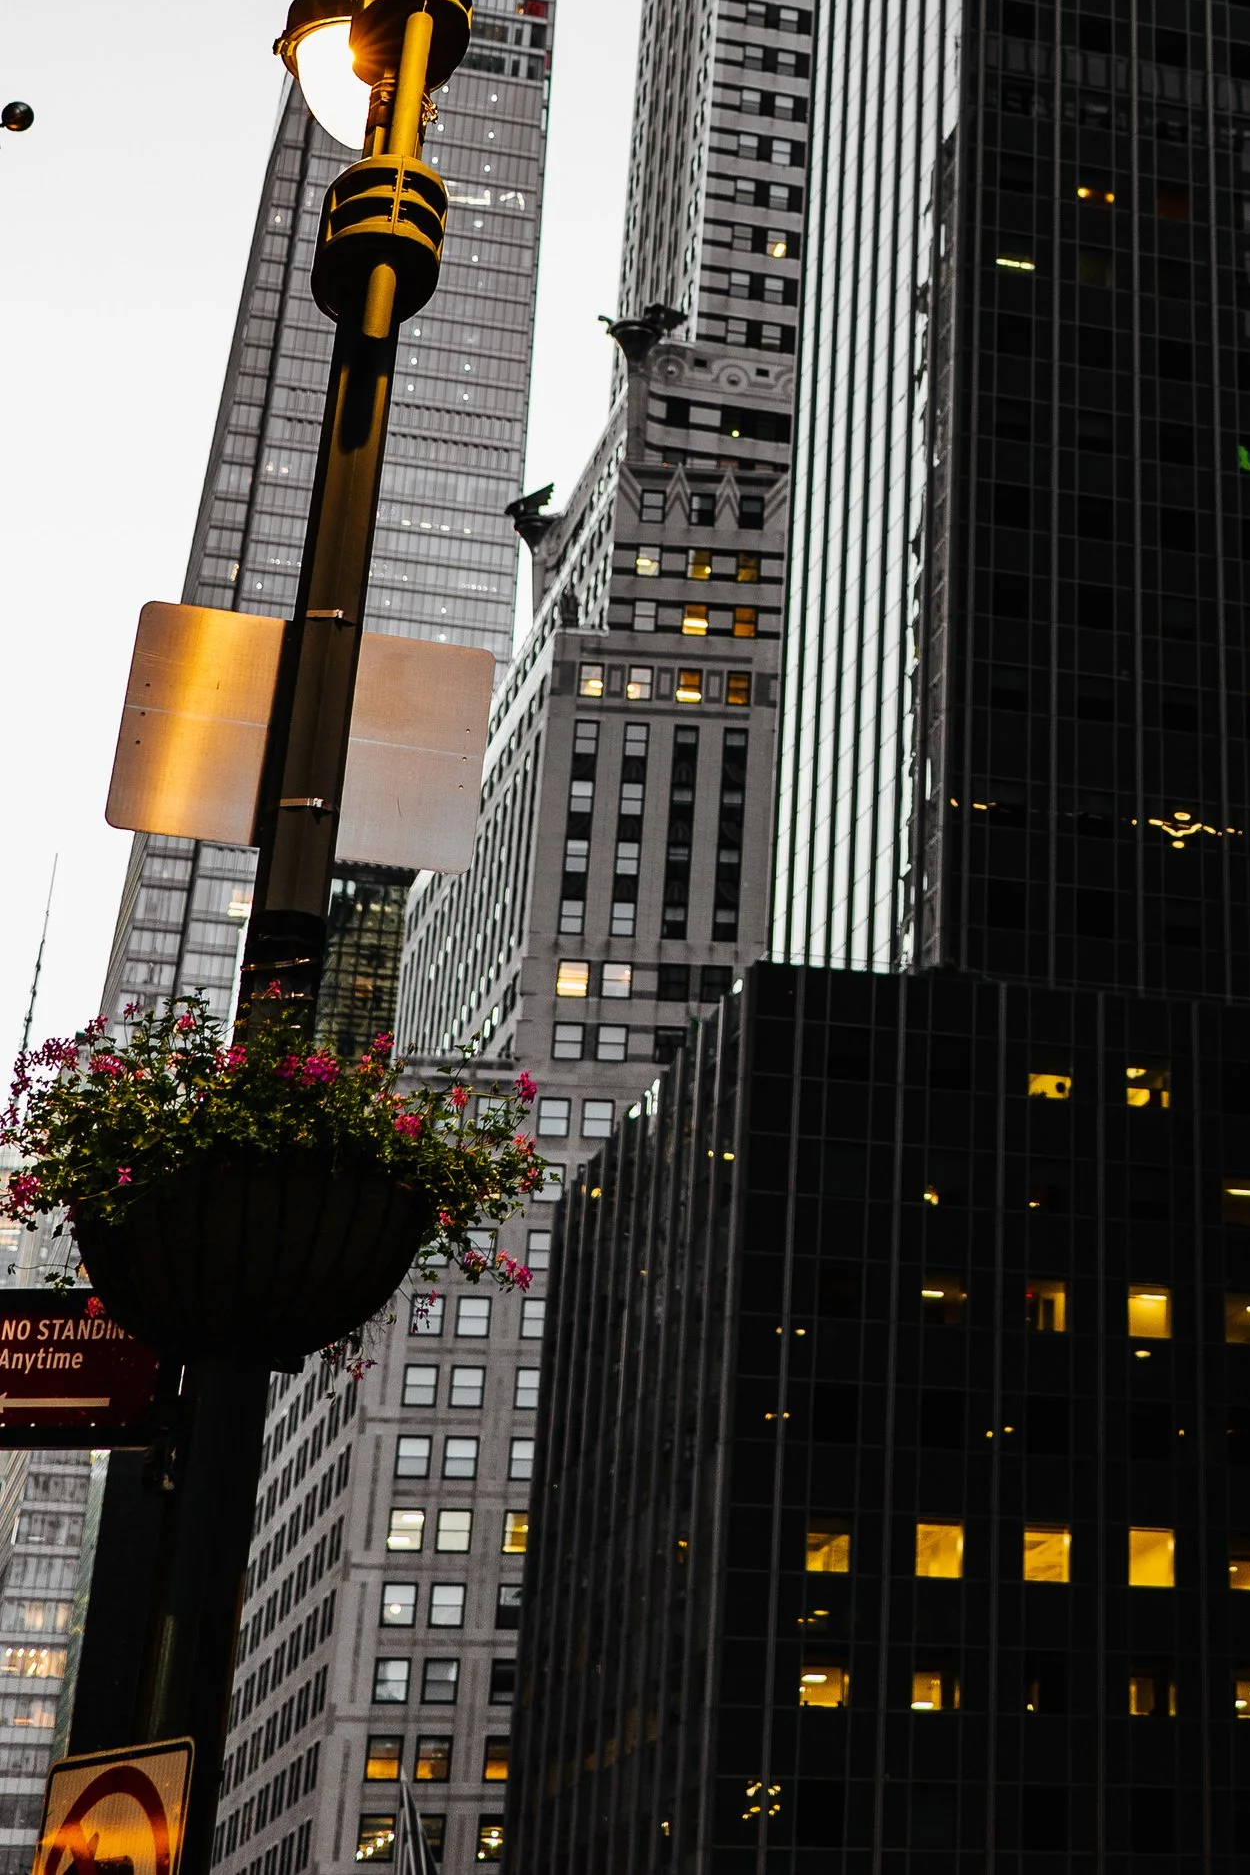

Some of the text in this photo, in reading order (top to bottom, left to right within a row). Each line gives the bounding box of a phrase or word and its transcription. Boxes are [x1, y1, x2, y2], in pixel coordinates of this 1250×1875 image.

[1, 1318, 136, 1341] NO STANDIN
[0, 1346, 84, 1375] Anytime
